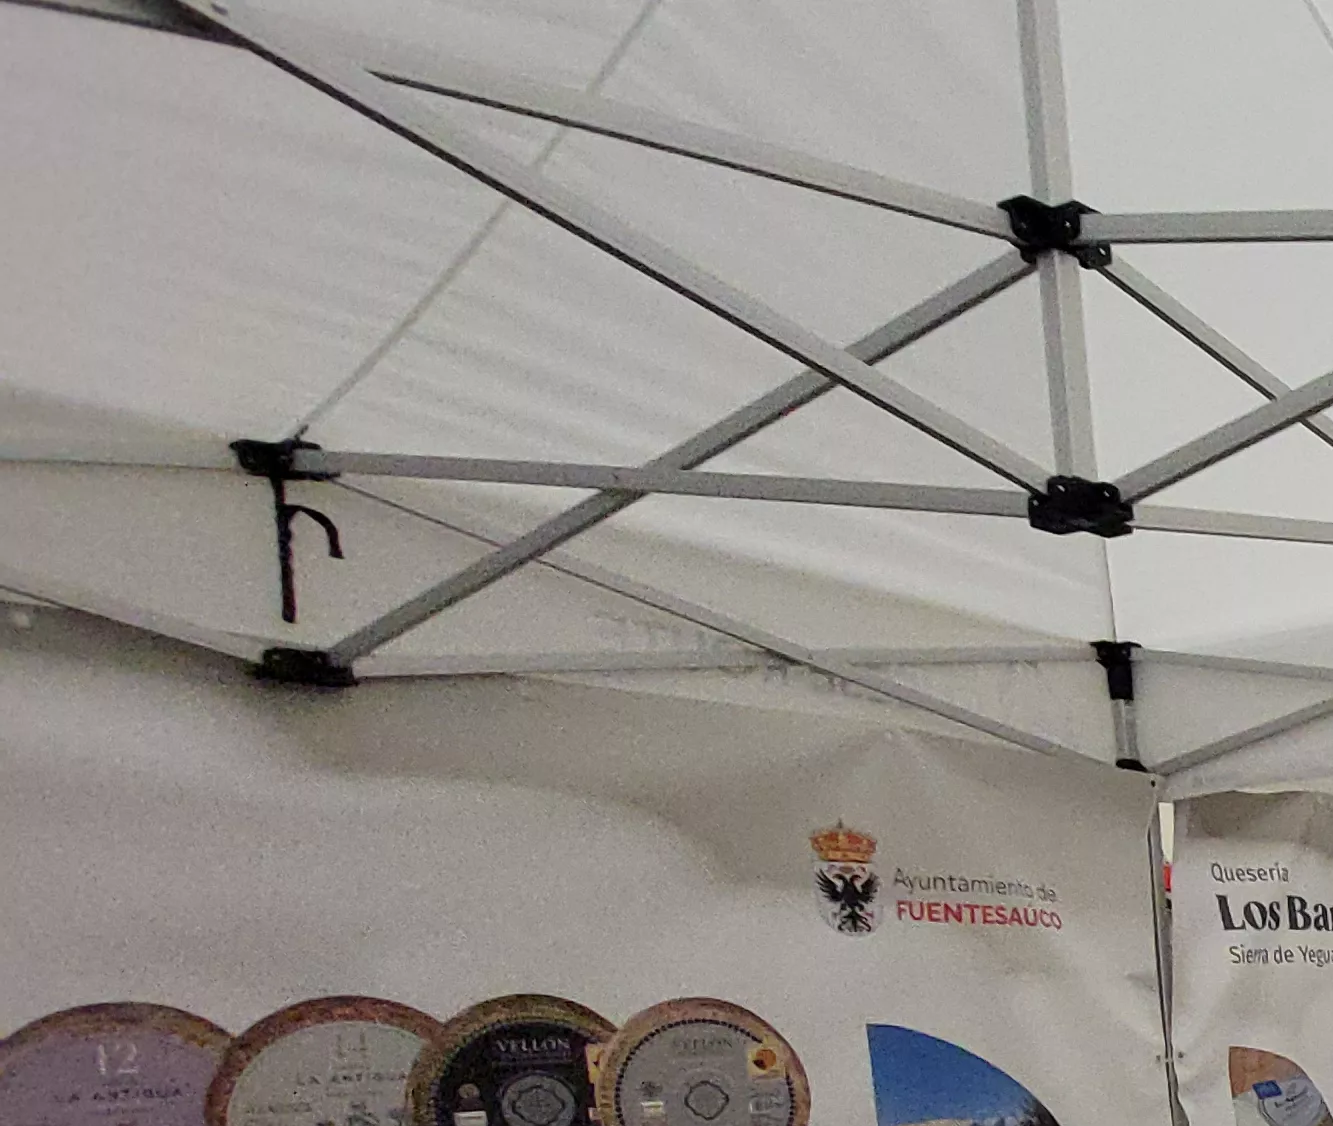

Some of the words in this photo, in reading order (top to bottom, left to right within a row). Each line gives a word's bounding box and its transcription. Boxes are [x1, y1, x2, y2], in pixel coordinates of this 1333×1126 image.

[893, 868, 1033, 898] Ayuntamiento
[1037, 885, 1057, 902] de
[1215, 894, 1281, 931] Los
[1273, 945, 1294, 964] de
